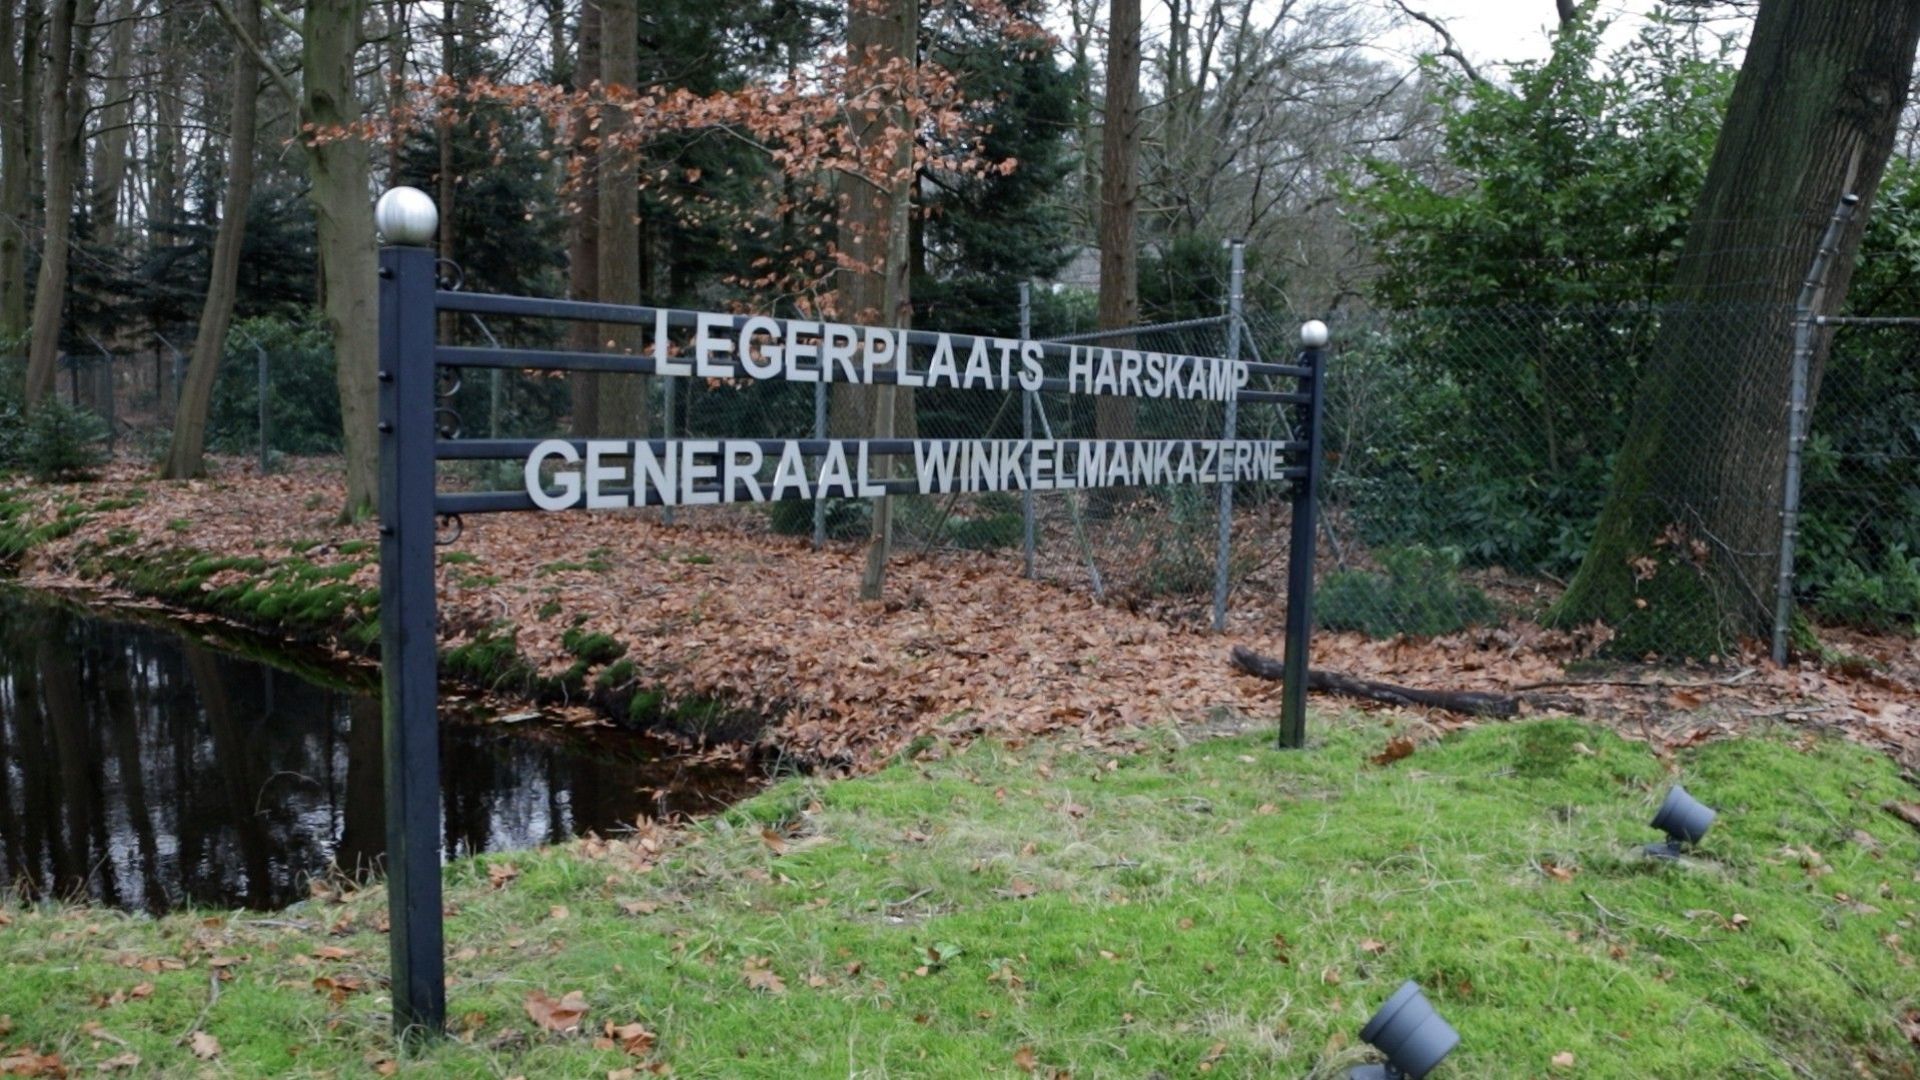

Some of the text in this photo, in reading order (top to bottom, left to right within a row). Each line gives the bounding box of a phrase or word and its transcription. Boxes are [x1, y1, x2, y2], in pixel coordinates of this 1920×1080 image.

[655, 308, 1248, 400] LEGERPLAATS HARSKAMP
[525, 439, 1285, 511] GENERAAL WINKELMANKAZERNE
